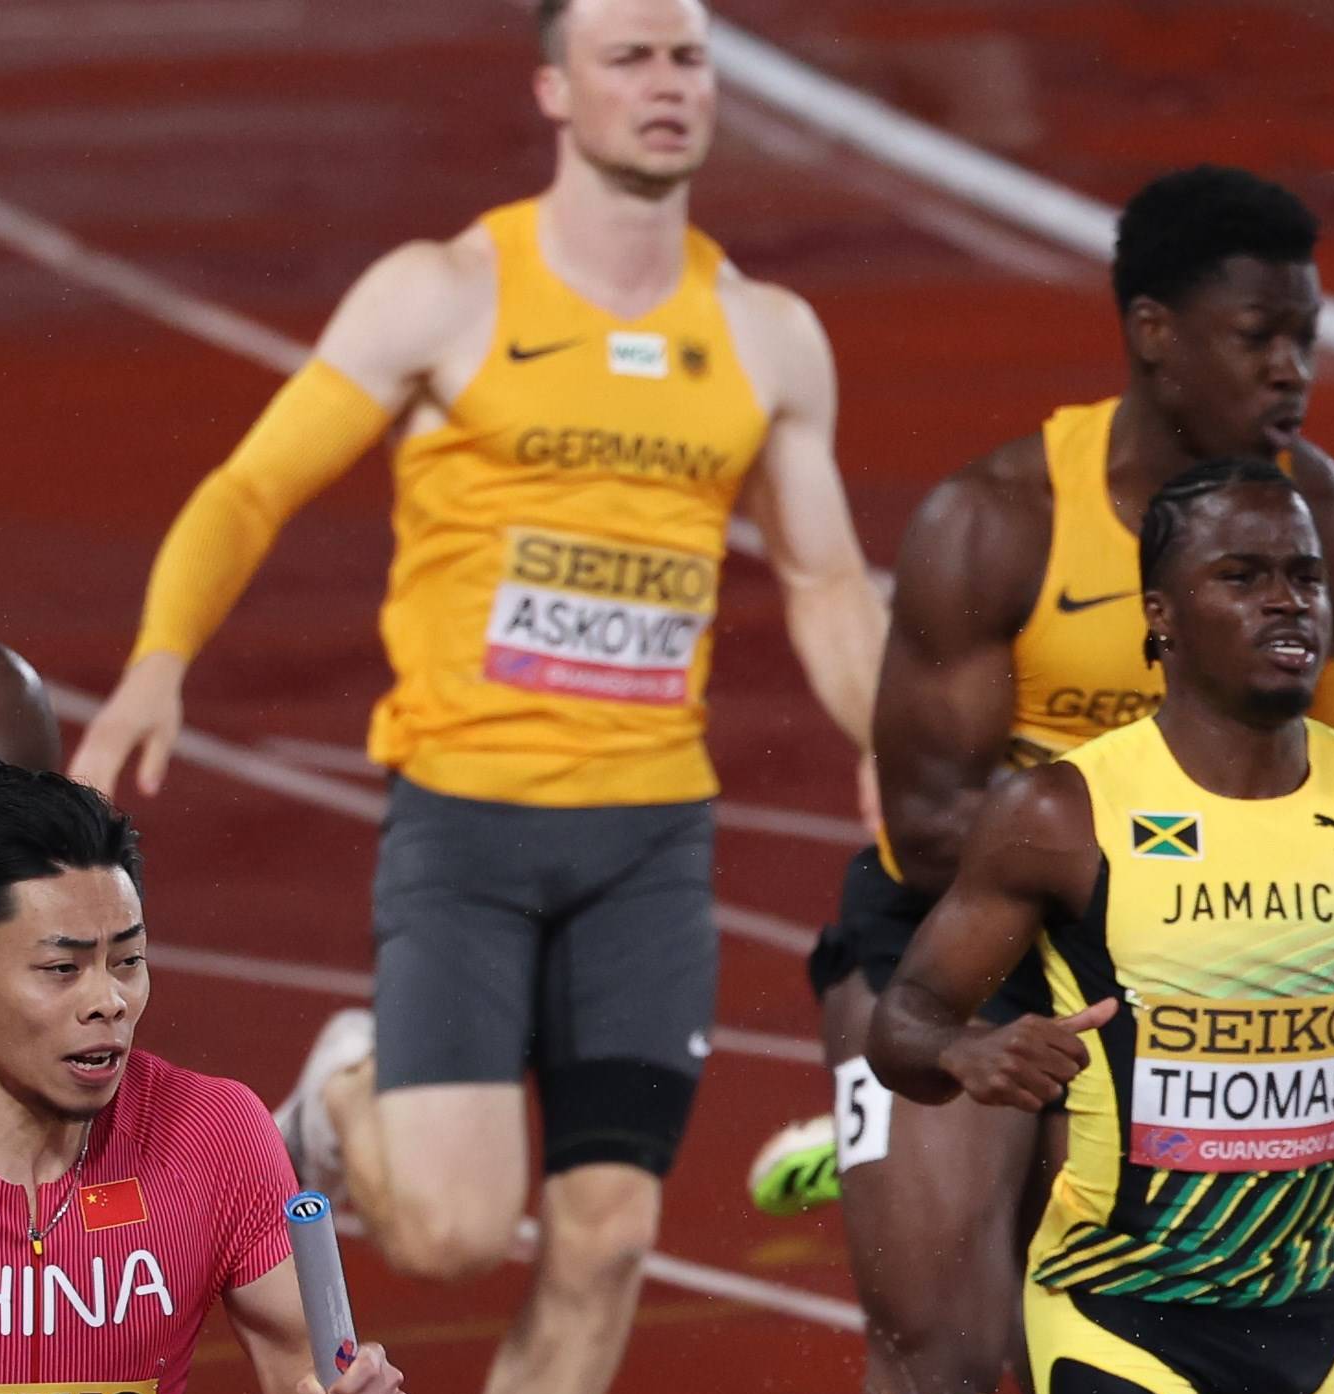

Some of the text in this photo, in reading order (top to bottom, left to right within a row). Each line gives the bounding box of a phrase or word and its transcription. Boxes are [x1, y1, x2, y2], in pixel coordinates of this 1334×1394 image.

[515, 427, 728, 480] GERMANY
[514, 535, 713, 605] SEIKO
[1045, 687, 1163, 726] GER
[849, 1077, 867, 1147] 5
[1198, 1136, 1326, 1161] GUANGZHOU
